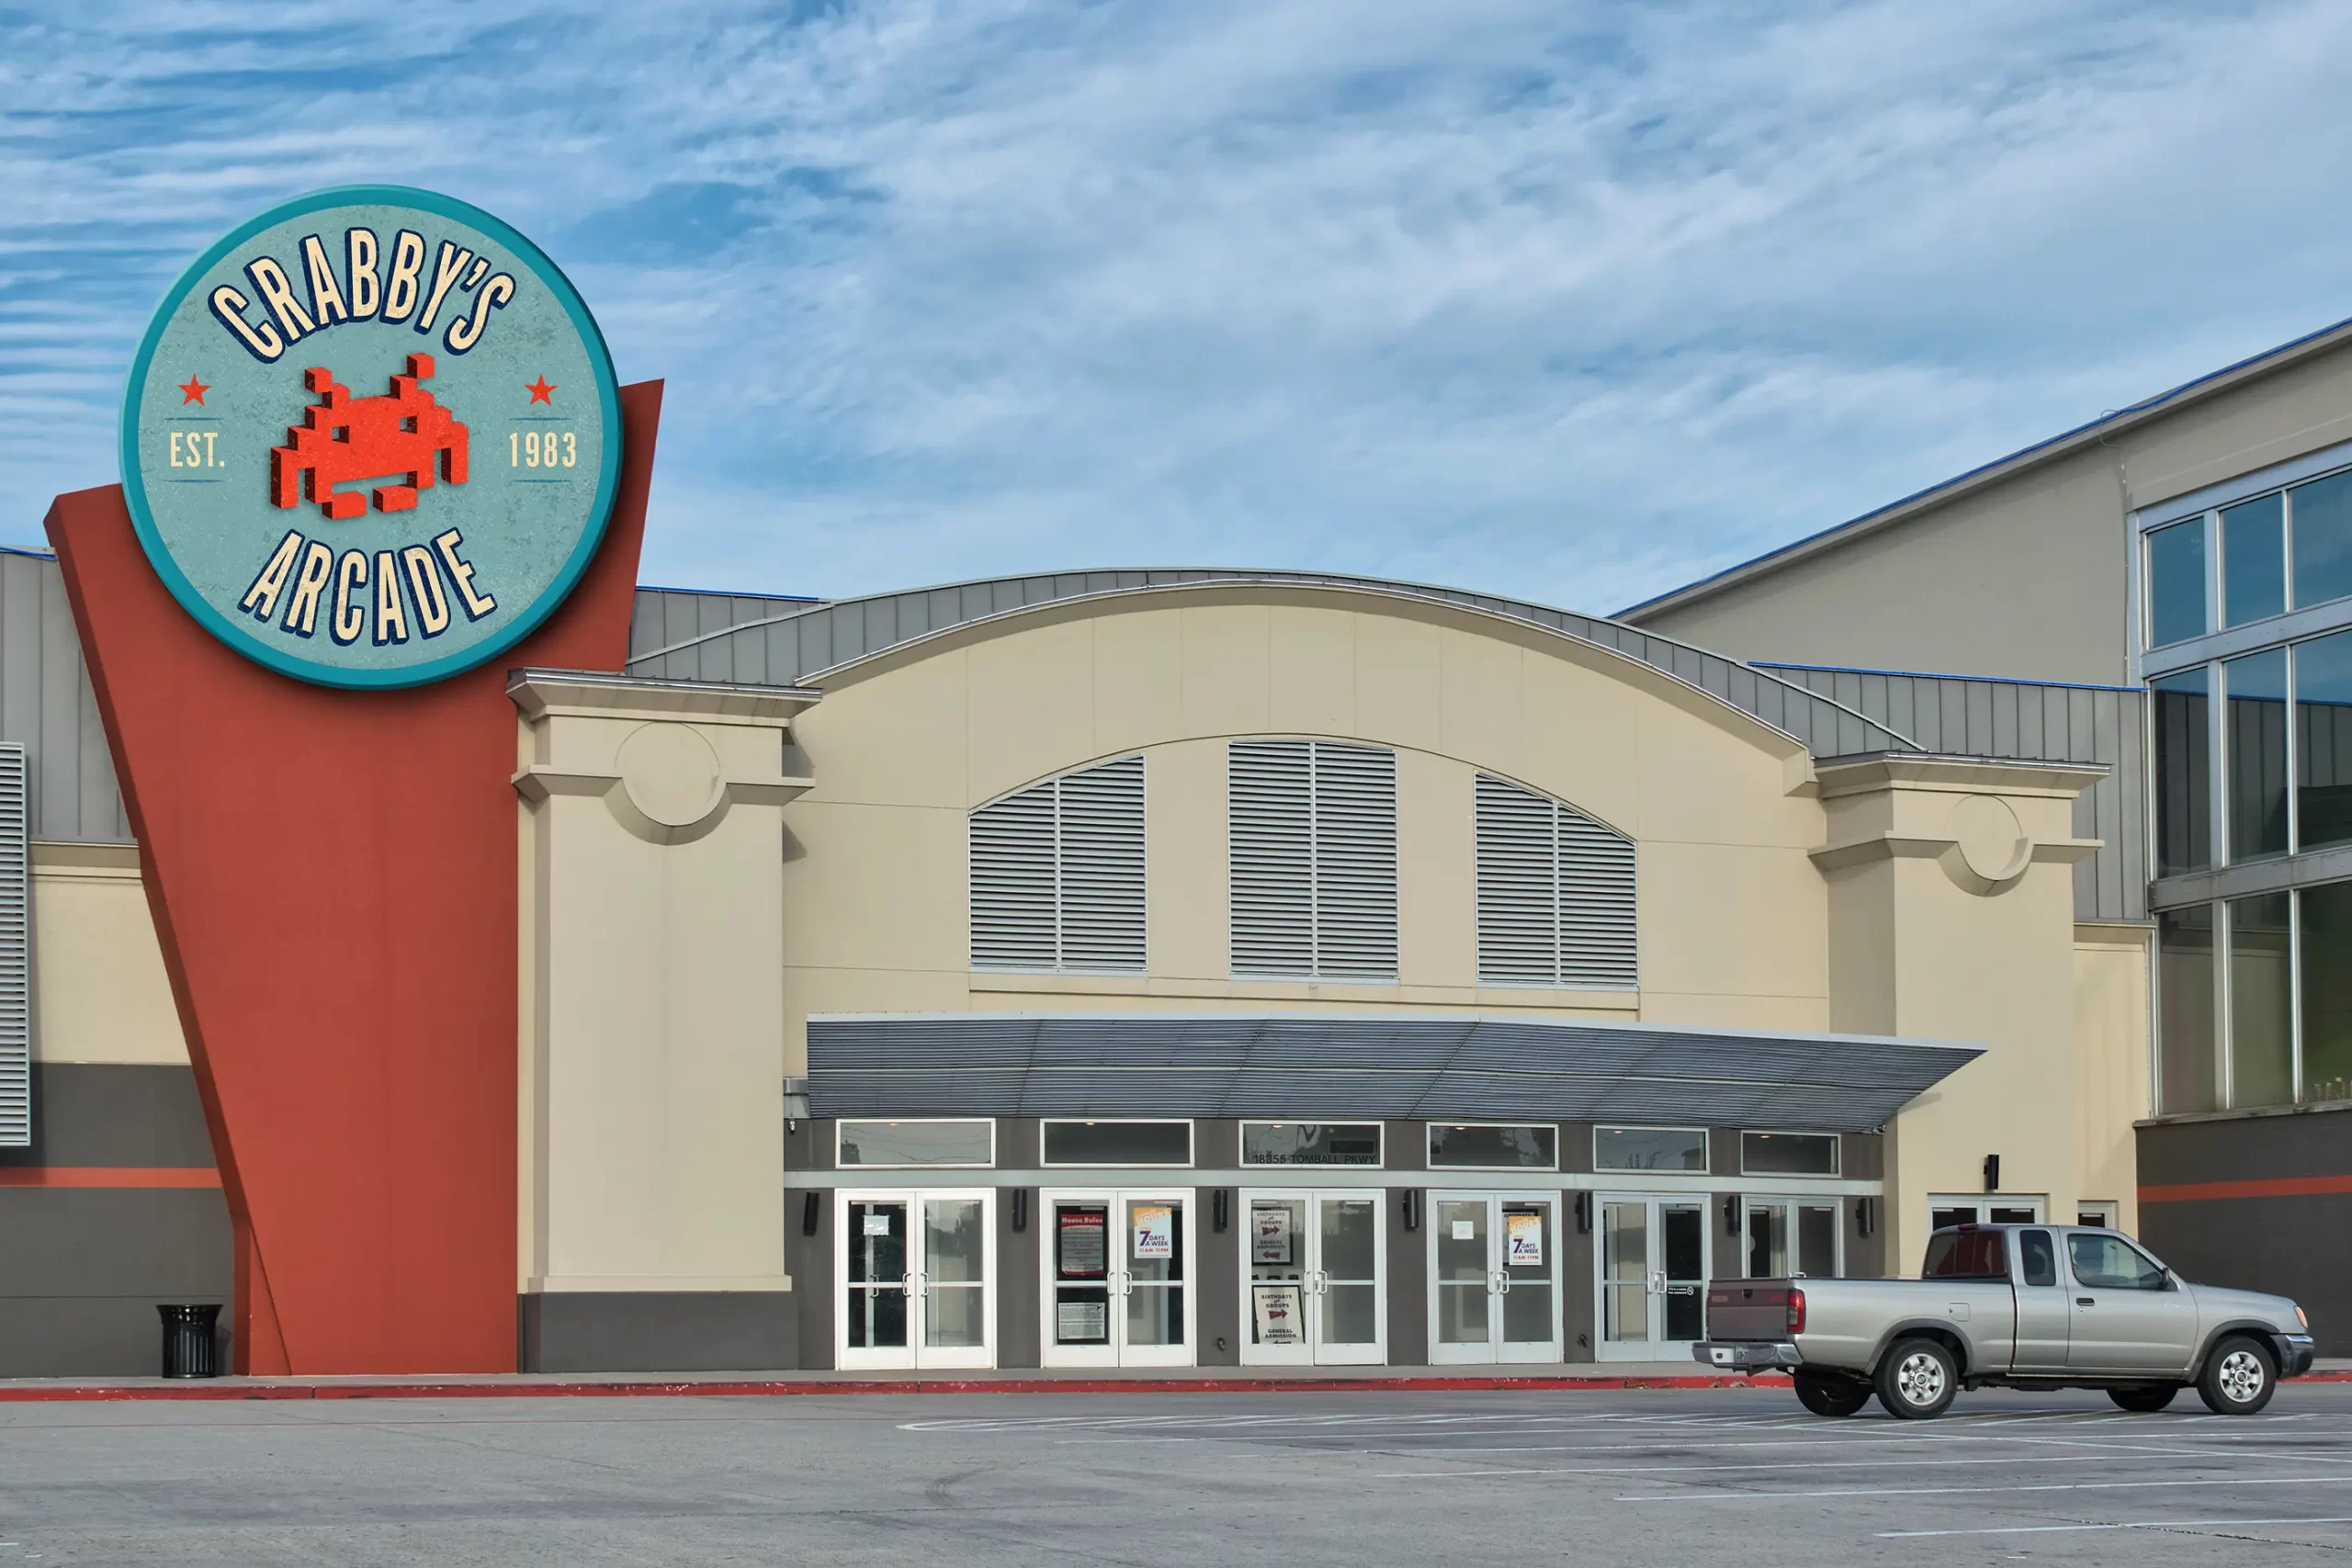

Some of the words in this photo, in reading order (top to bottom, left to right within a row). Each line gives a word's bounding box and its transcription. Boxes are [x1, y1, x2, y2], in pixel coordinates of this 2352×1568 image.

[208, 228, 516, 364] CRABBY'S
[170, 432, 225, 468] EST.
[509, 432, 577, 468] 1983
[237, 527, 498, 646] ARCADE
[1255, 1155, 1286, 1164] 18355
[1291, 1155, 1340, 1164] TOMBALL
[1344, 1155, 1375, 1164] PKWY
[1139, 1230, 1151, 1246] 7
[1513, 1238, 1523, 1253] 7
